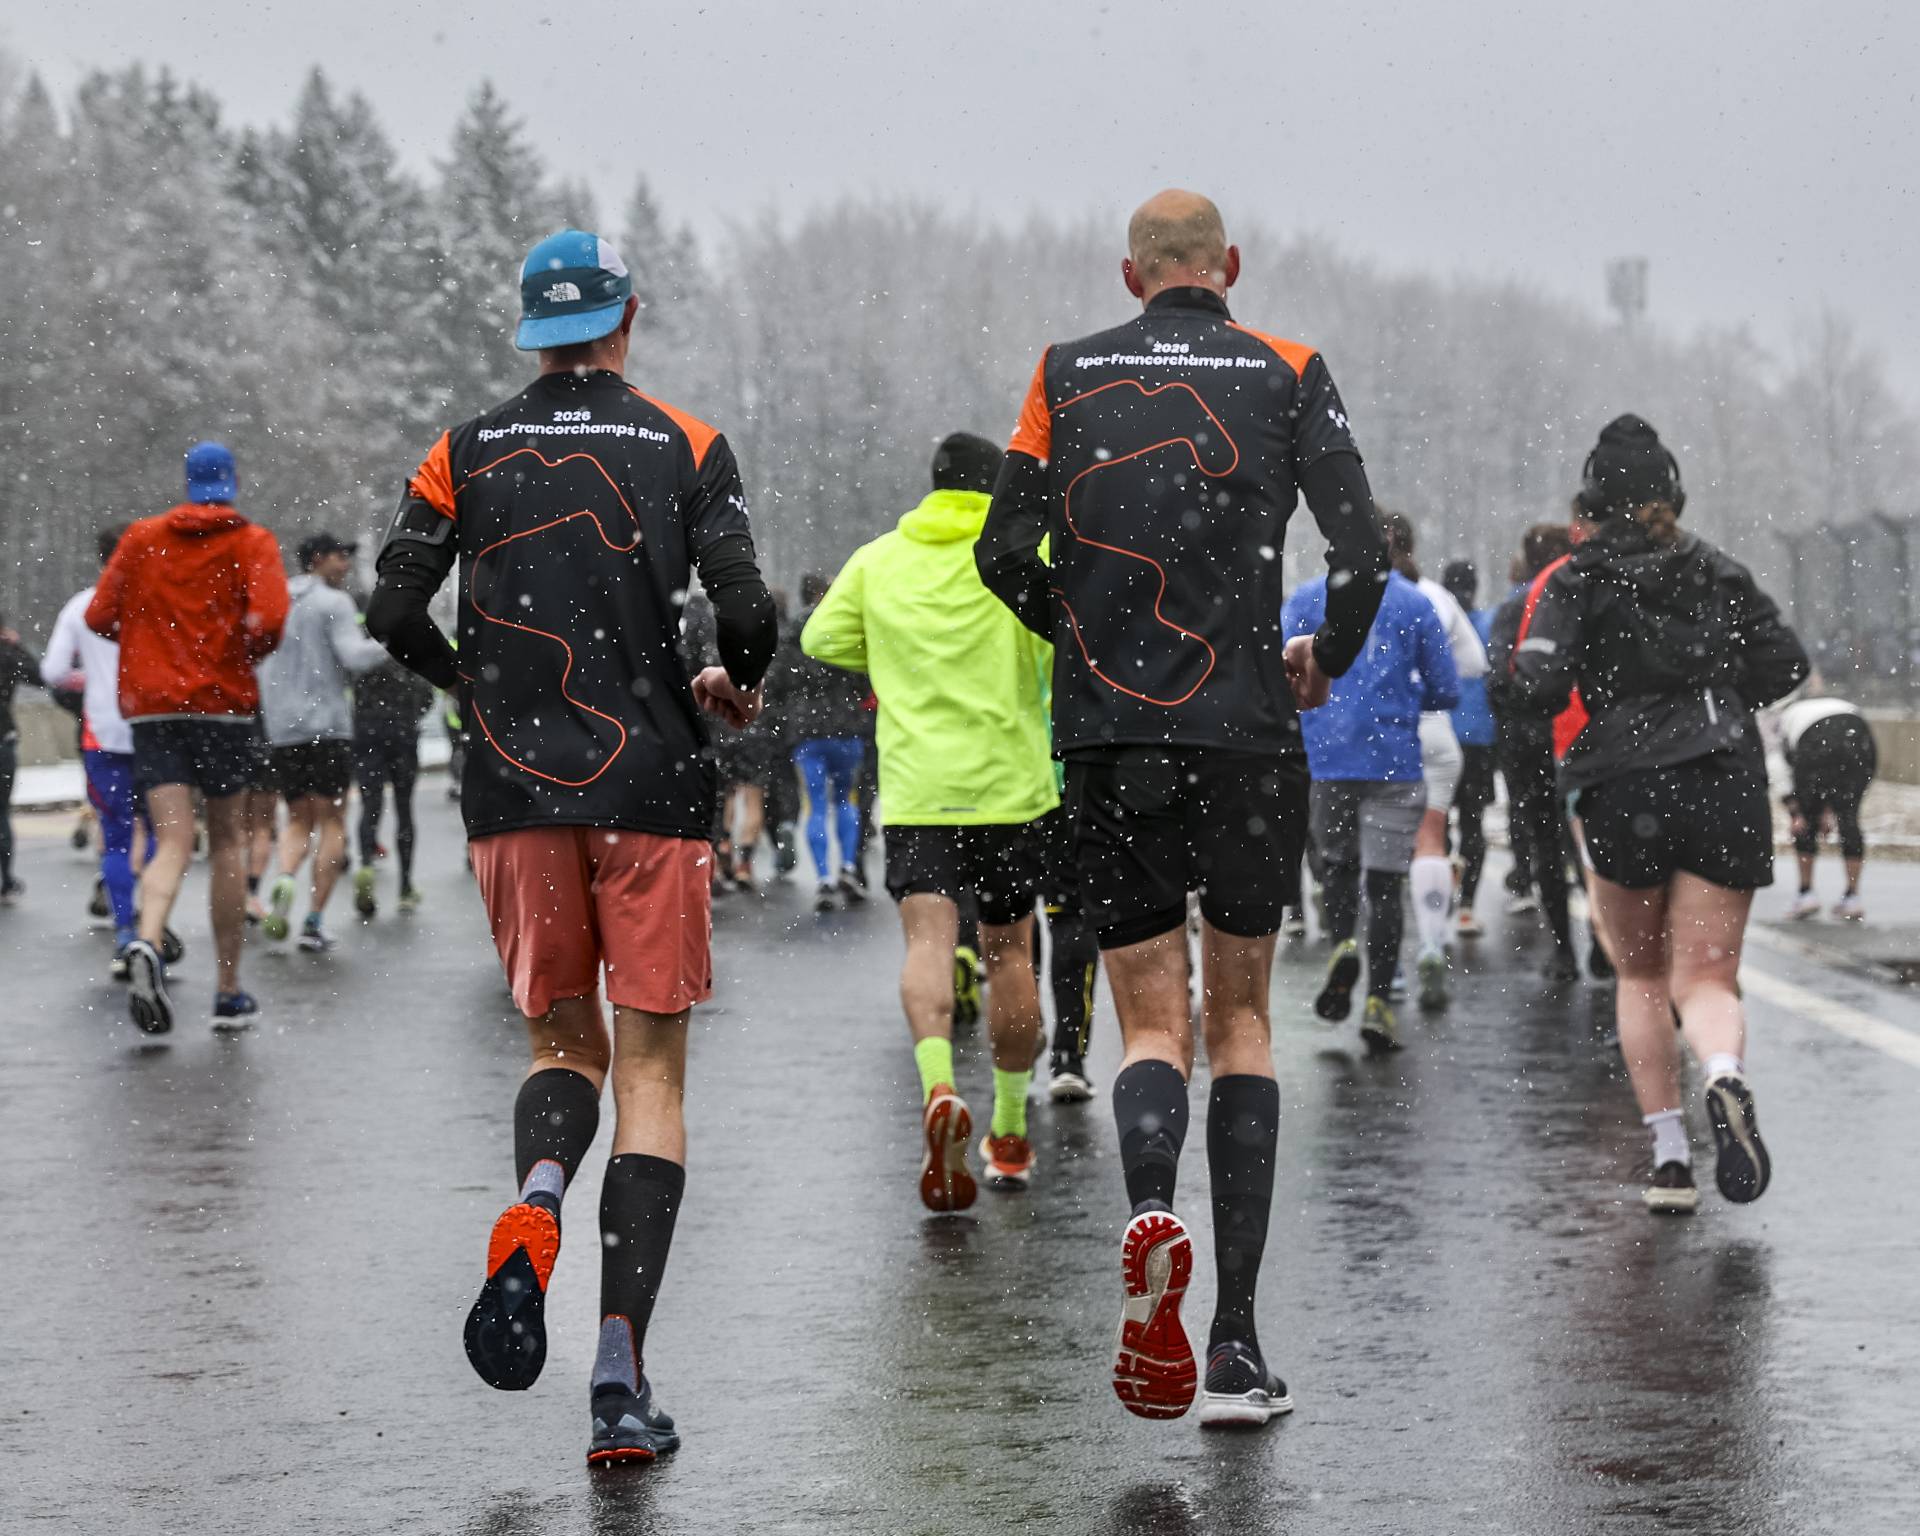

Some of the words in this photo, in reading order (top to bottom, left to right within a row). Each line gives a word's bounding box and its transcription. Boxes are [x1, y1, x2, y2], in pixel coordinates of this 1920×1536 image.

[1152, 342, 1190, 353] 2026
[1235, 357, 1267, 369] Run
[553, 411, 592, 422] 2026
[638, 428, 670, 443] Run
